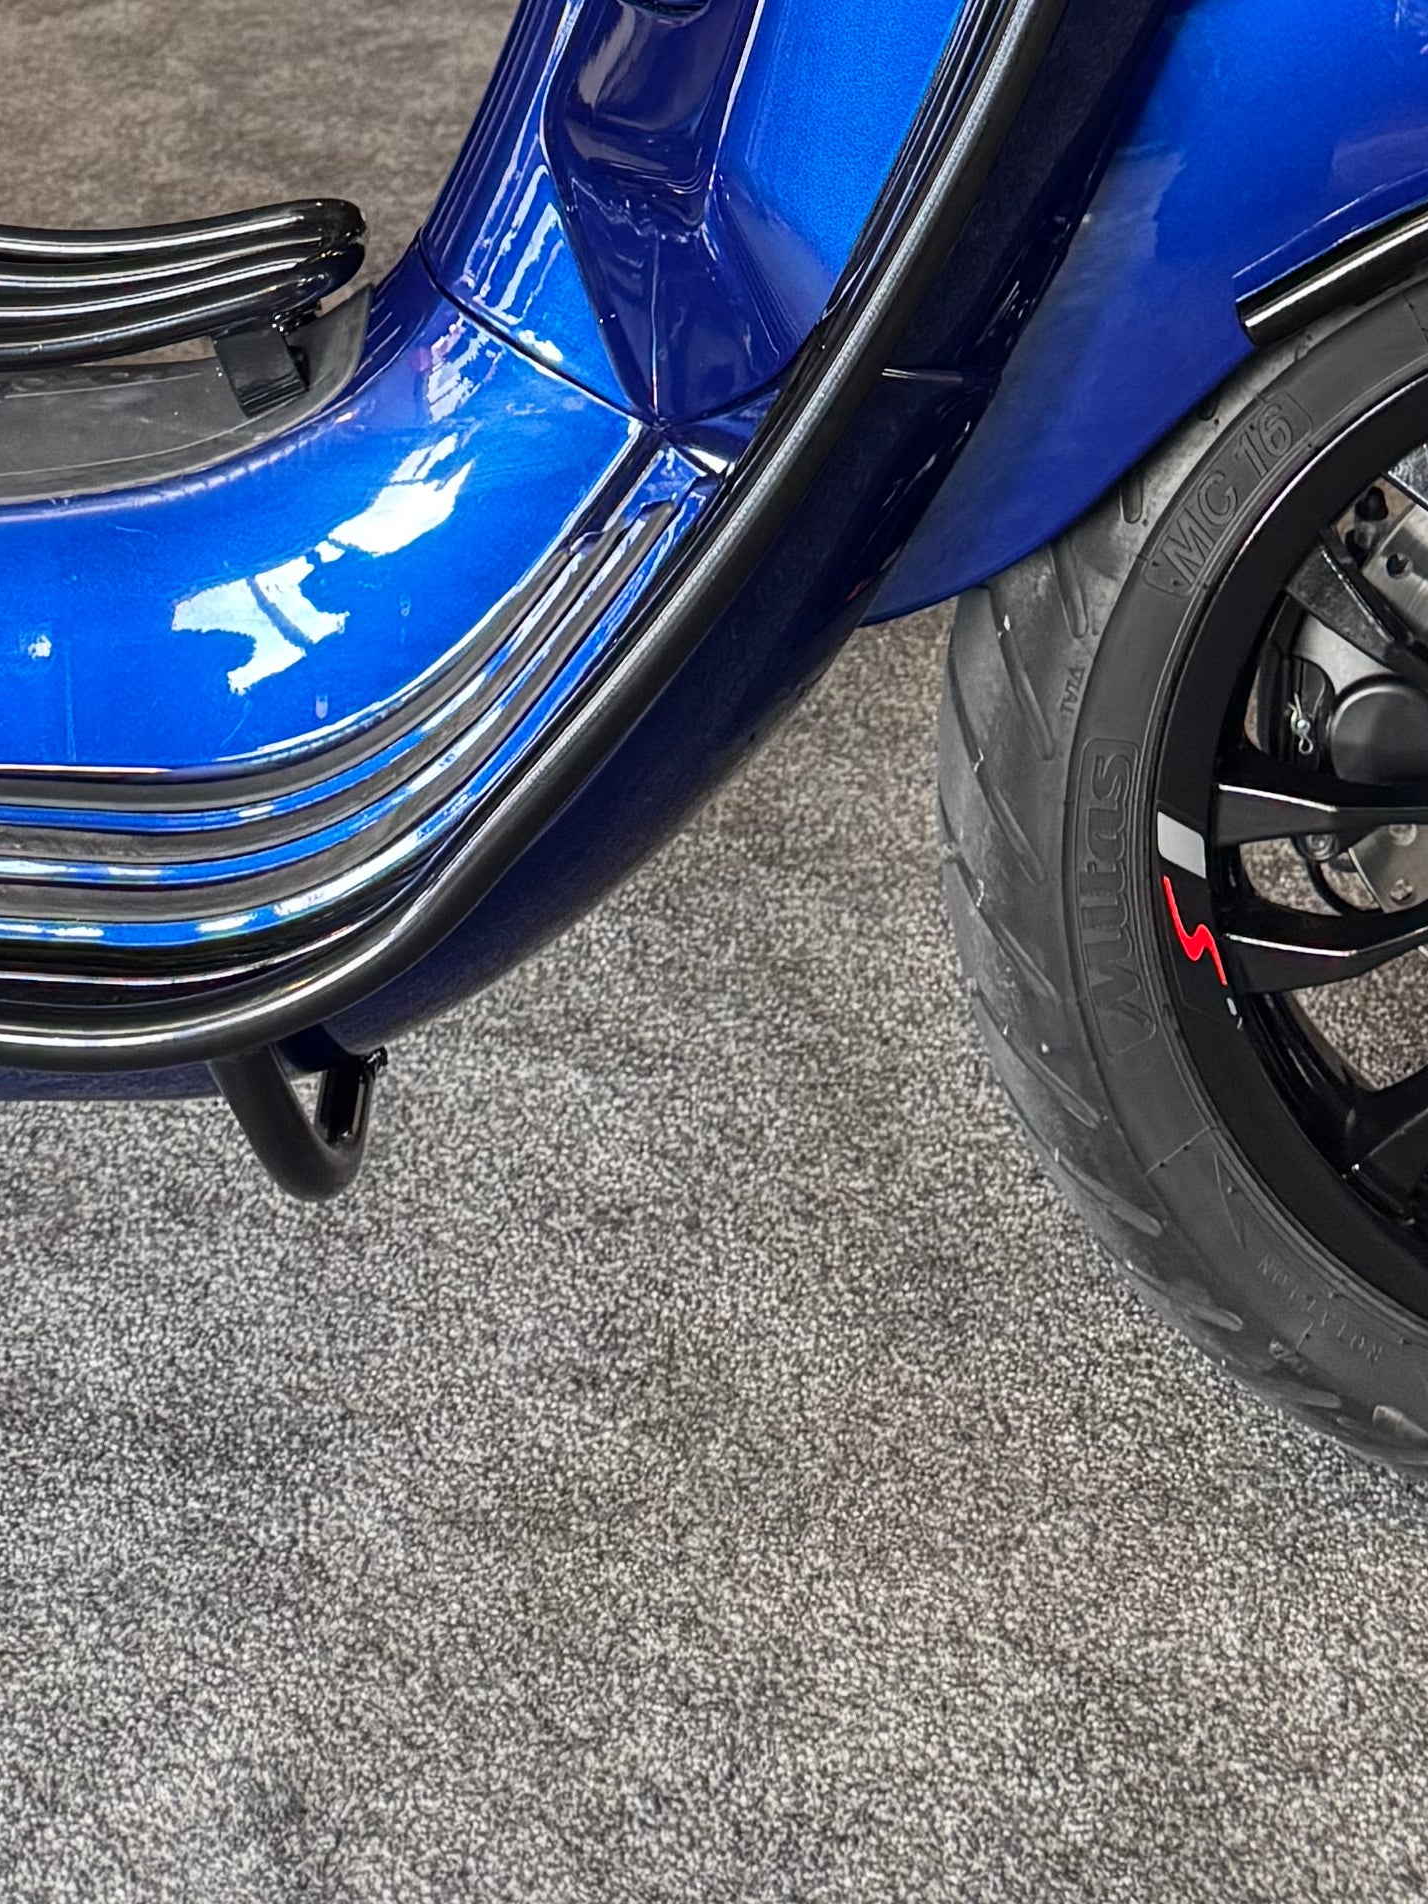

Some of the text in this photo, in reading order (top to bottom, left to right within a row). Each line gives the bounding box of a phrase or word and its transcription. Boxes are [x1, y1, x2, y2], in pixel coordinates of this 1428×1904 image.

[1162, 403, 1294, 584] MC 16
[1078, 752, 1152, 1028] Mitas
